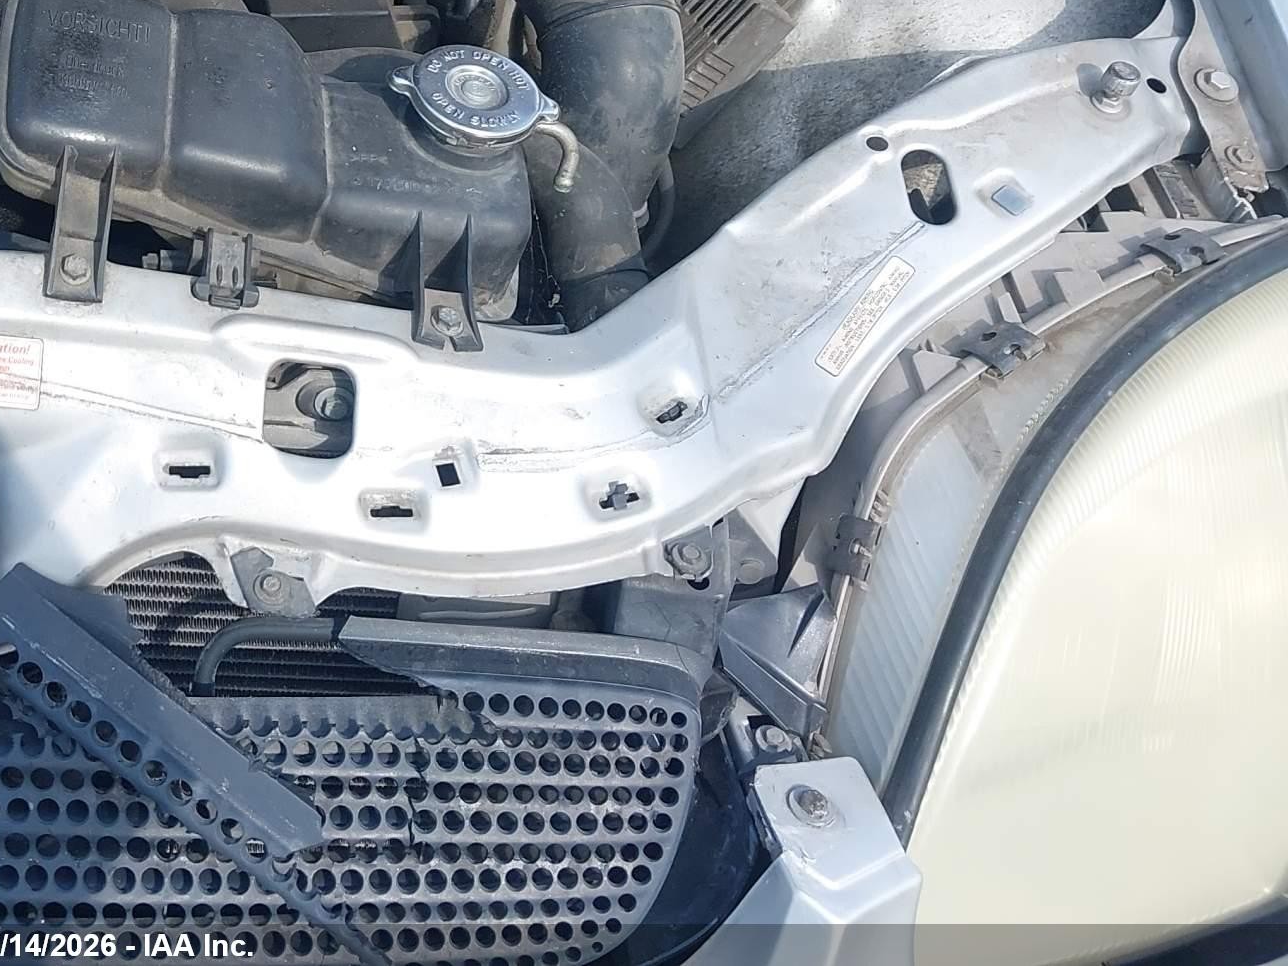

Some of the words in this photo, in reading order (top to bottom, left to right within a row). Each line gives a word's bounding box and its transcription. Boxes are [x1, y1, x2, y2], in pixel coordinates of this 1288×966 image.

[426, 59, 443, 74] DO
[444, 50, 466, 63] NOT
[472, 50, 511, 72] OPEN
[508, 70, 530, 90] HOT
[431, 92, 465, 120] OPEN
